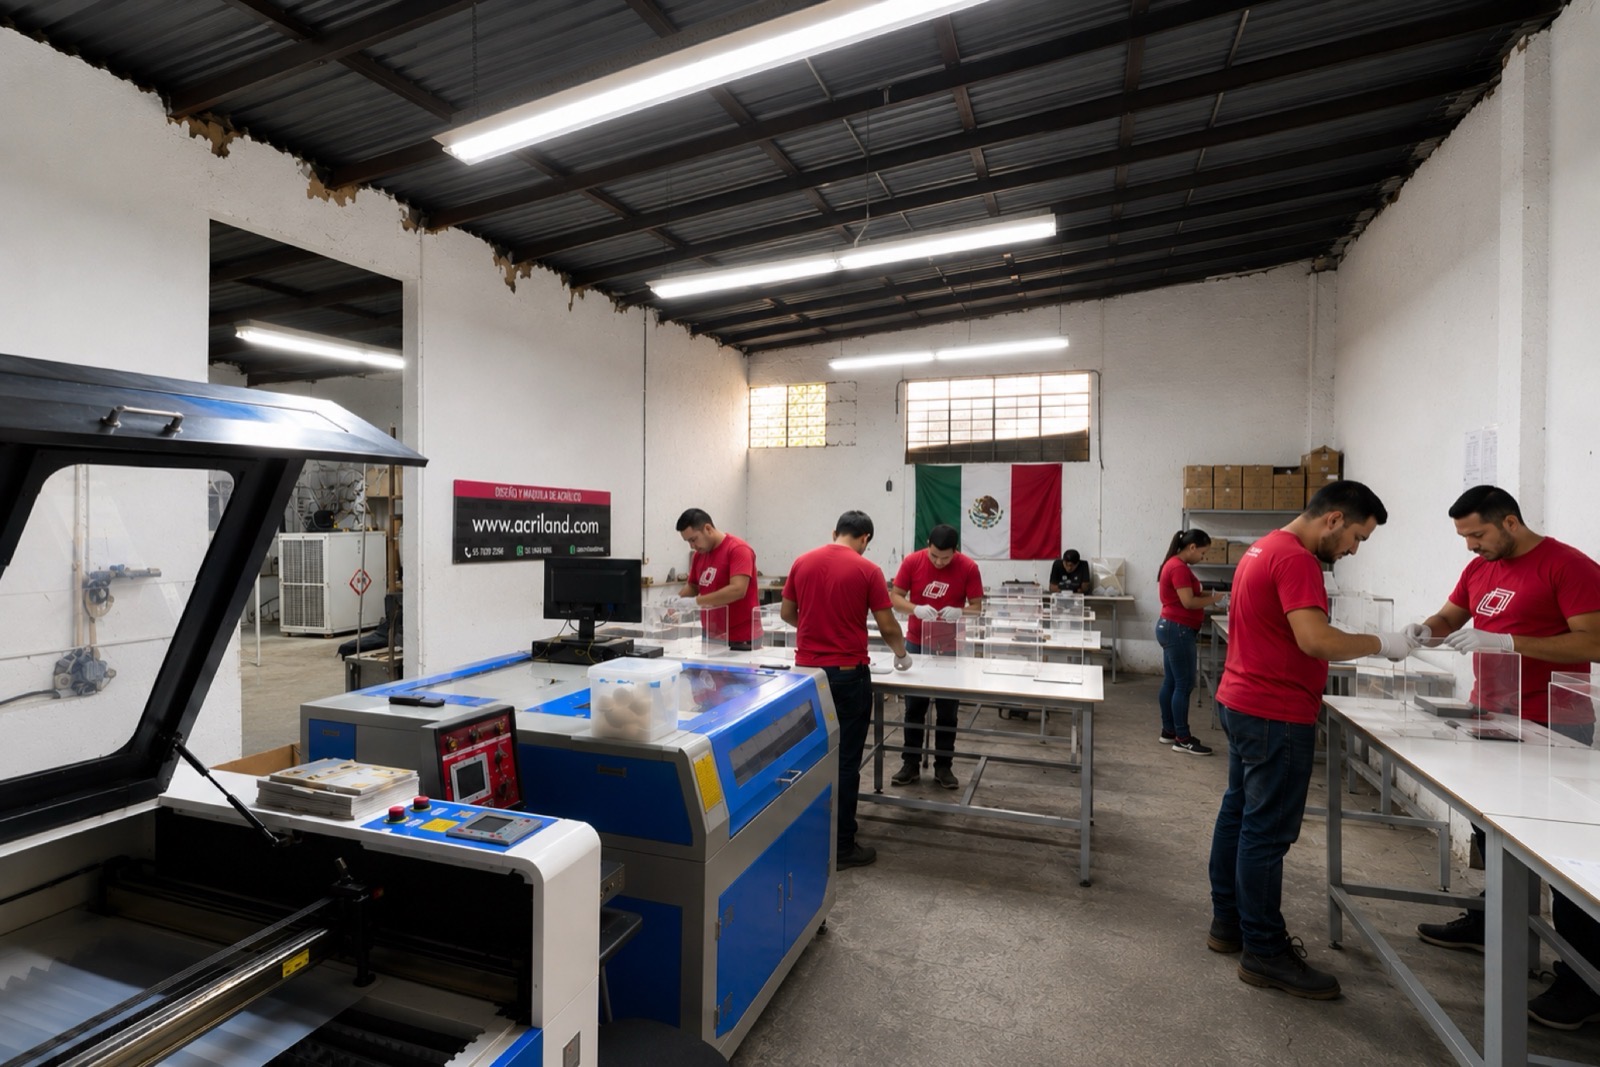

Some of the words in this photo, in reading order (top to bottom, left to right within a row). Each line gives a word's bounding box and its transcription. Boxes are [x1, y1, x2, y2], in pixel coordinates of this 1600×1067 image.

[495, 486, 517, 498] DISEÑO
[518, 489, 523, 498] Y
[523, 488, 548, 500] MAQUILA
[549, 490, 557, 500] DE
[472, 512, 599, 534] www.acriland.com
